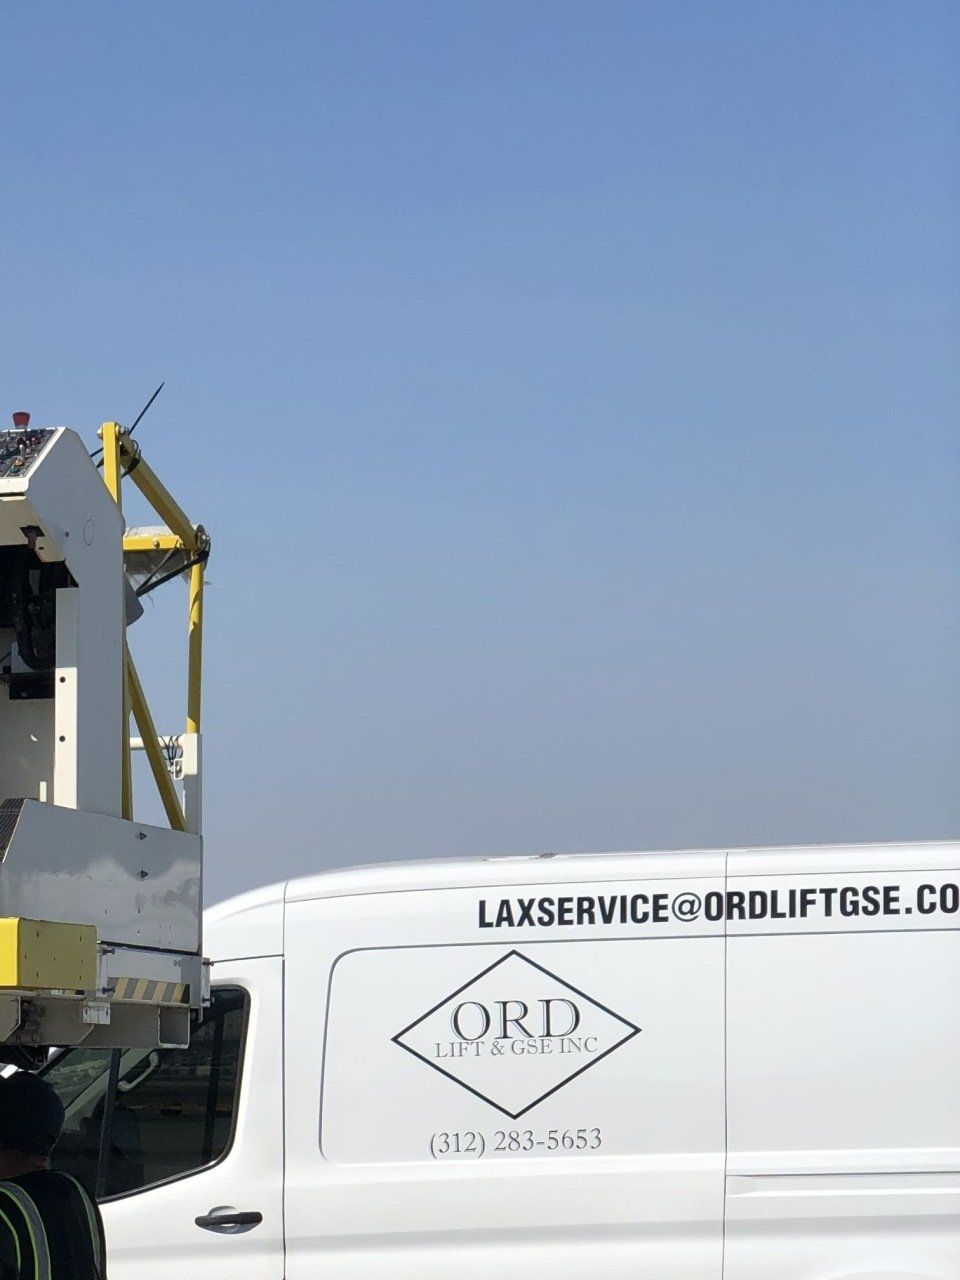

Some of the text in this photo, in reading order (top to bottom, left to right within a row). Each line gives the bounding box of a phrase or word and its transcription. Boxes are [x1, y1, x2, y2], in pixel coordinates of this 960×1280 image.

[478, 883, 959, 929] LAXSERVICE@ORDLIFTGSE.CO
[450, 998, 581, 1041] ORD
[434, 1036, 599, 1058] LIFT & GSE INC
[430, 1127, 602, 1159] (312) 283-5653
